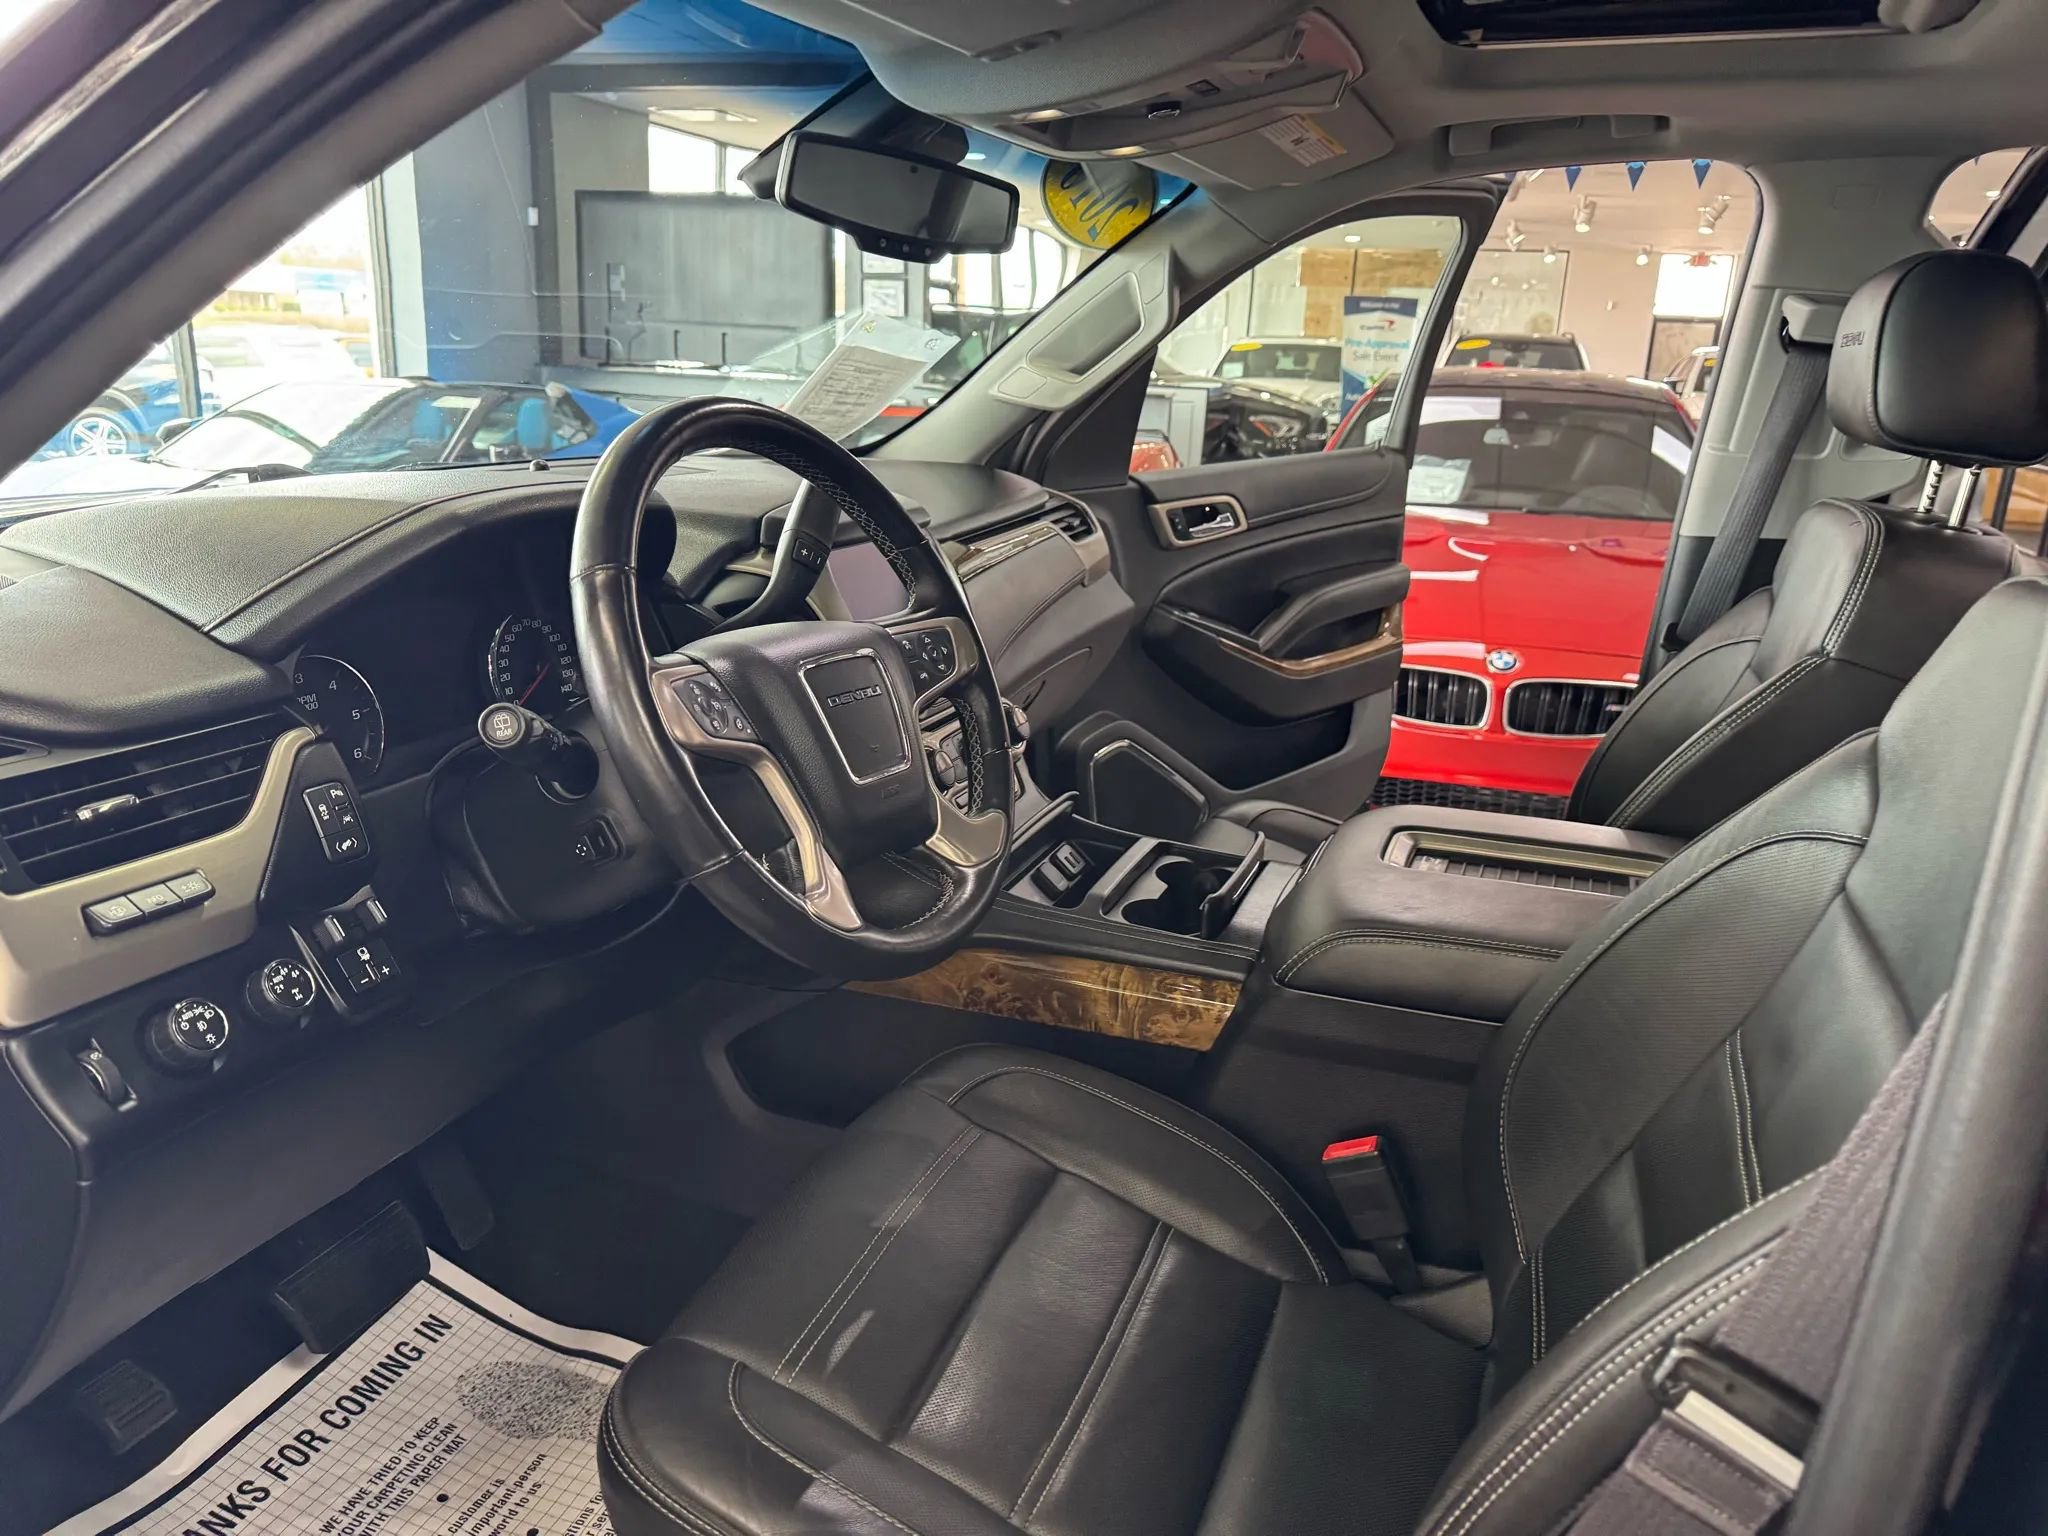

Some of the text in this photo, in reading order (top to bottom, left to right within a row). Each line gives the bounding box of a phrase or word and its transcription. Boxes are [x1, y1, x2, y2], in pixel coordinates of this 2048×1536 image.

[511, 624, 522, 632] 60
[531, 619, 541, 628] 80
[541, 625, 552, 633] 90
[504, 634, 515, 642] 50
[549, 634, 560, 642] 100
[498, 659, 508, 667] 30
[560, 656, 571, 664] 120
[500, 673, 510, 682] 20
[562, 669, 573, 678] 130
[329, 680, 337, 690] 4
[561, 684, 573, 693] 140
[505, 687, 513, 695] 10
[352, 709, 361, 720] 5
[496, 728, 513, 737] REAR
[353, 748, 362, 759] 6
[260, 1429, 332, 1482] FOR
[319, 1340, 426, 1430] COMING
[413, 1313, 453, 1343] IN
[366, 1453, 426, 1509] CARPETING
[423, 1423, 458, 1454] CLEAN
[319, 1417, 440, 1534] WE HAVE TRIED TO KEEP
[384, 1487, 414, 1512] THIS
[410, 1455, 447, 1487] PAPER
[442, 1433, 467, 1456] MAT
[465, 1454, 547, 1536] important person
[448, 1479, 505, 1534] customer is
[489, 1509, 519, 1536] world
[514, 1497, 529, 1507] to
[592, 1508, 608, 1529] ser
